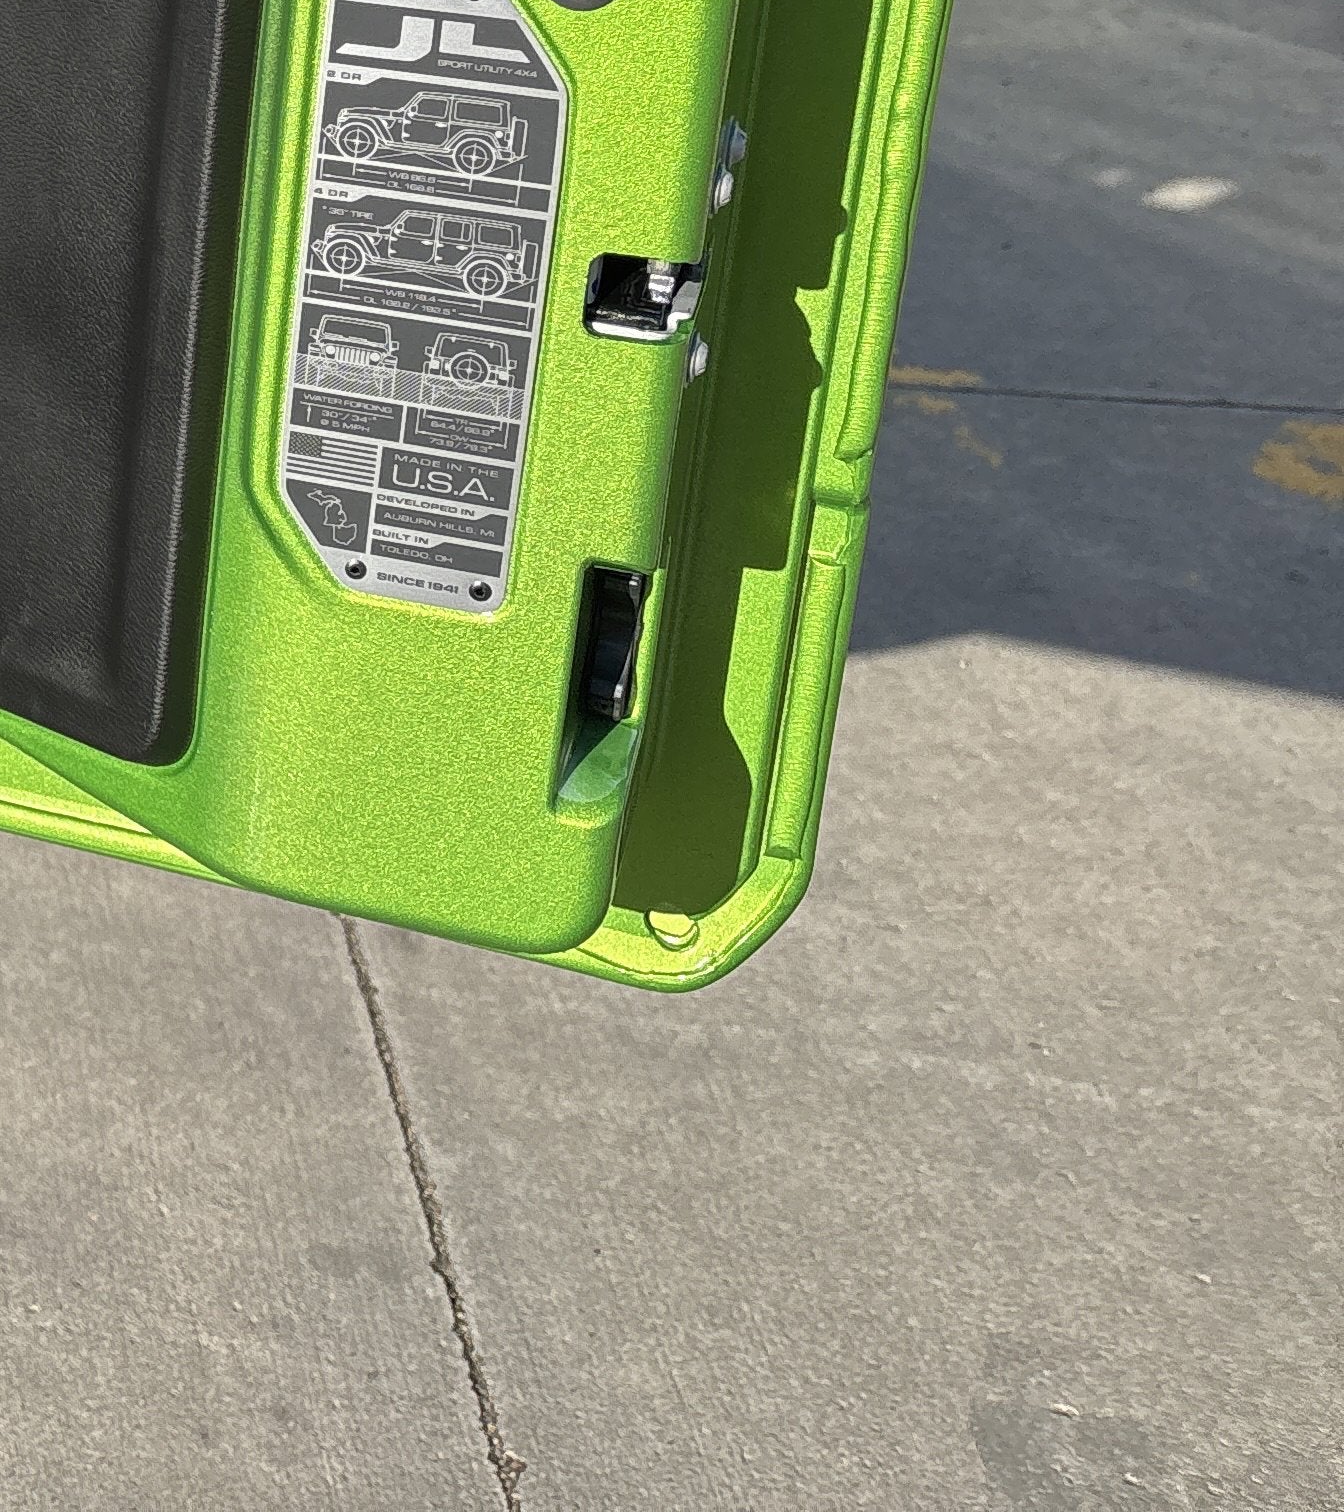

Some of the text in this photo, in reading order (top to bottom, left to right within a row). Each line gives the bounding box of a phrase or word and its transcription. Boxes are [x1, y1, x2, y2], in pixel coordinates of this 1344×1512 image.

[335, 15, 531, 64] JL
[437, 59, 473, 71] SPORT
[474, 63, 513, 75] UTILITY
[340, 71, 362, 81] DR
[388, 170, 409, 180] WB
[328, 189, 349, 198] DR
[350, 209, 374, 220] TIRE
[385, 288, 405, 298] WB
[303, 392, 393, 414] WATER FORDING
[342, 422, 370, 432] MPH
[394, 453, 500, 478] MADE IN THE
[392, 464, 495, 502] U.S.A.
[376, 493, 475, 517] DEVELOPED IN
[383, 511, 437, 528] AUBURN
[480, 527, 495, 538] MI
[372, 528, 429, 545] BUILT IN
[434, 553, 453, 564] OH
[376, 571, 459, 595] SINCE 1941
